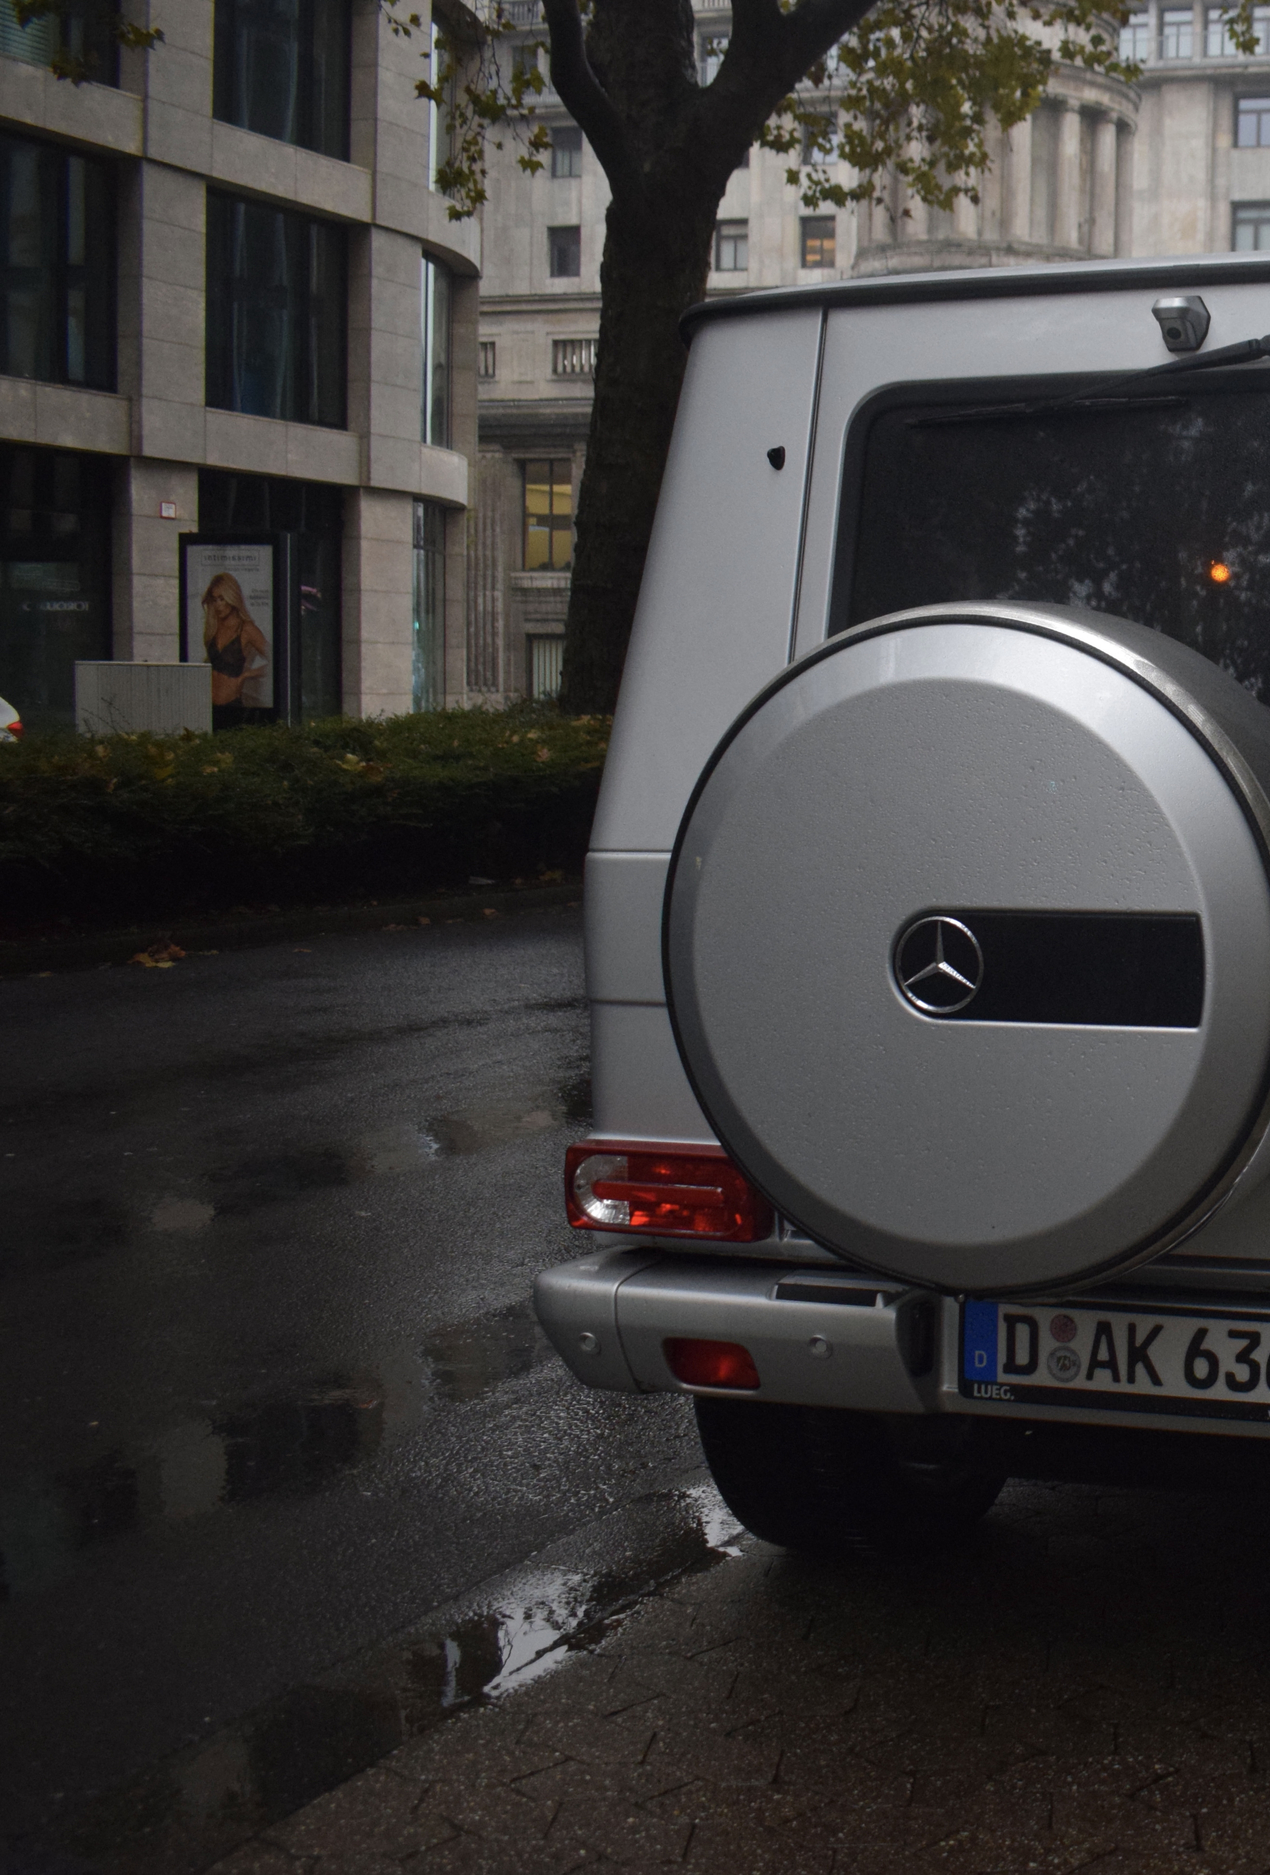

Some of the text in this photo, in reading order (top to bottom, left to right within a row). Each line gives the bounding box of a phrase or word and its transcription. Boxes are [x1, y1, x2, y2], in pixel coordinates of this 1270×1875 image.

[974, 1350, 987, 1368] D
[1002, 1312, 1039, 1376] D
[1085, 1320, 1164, 1388] AK
